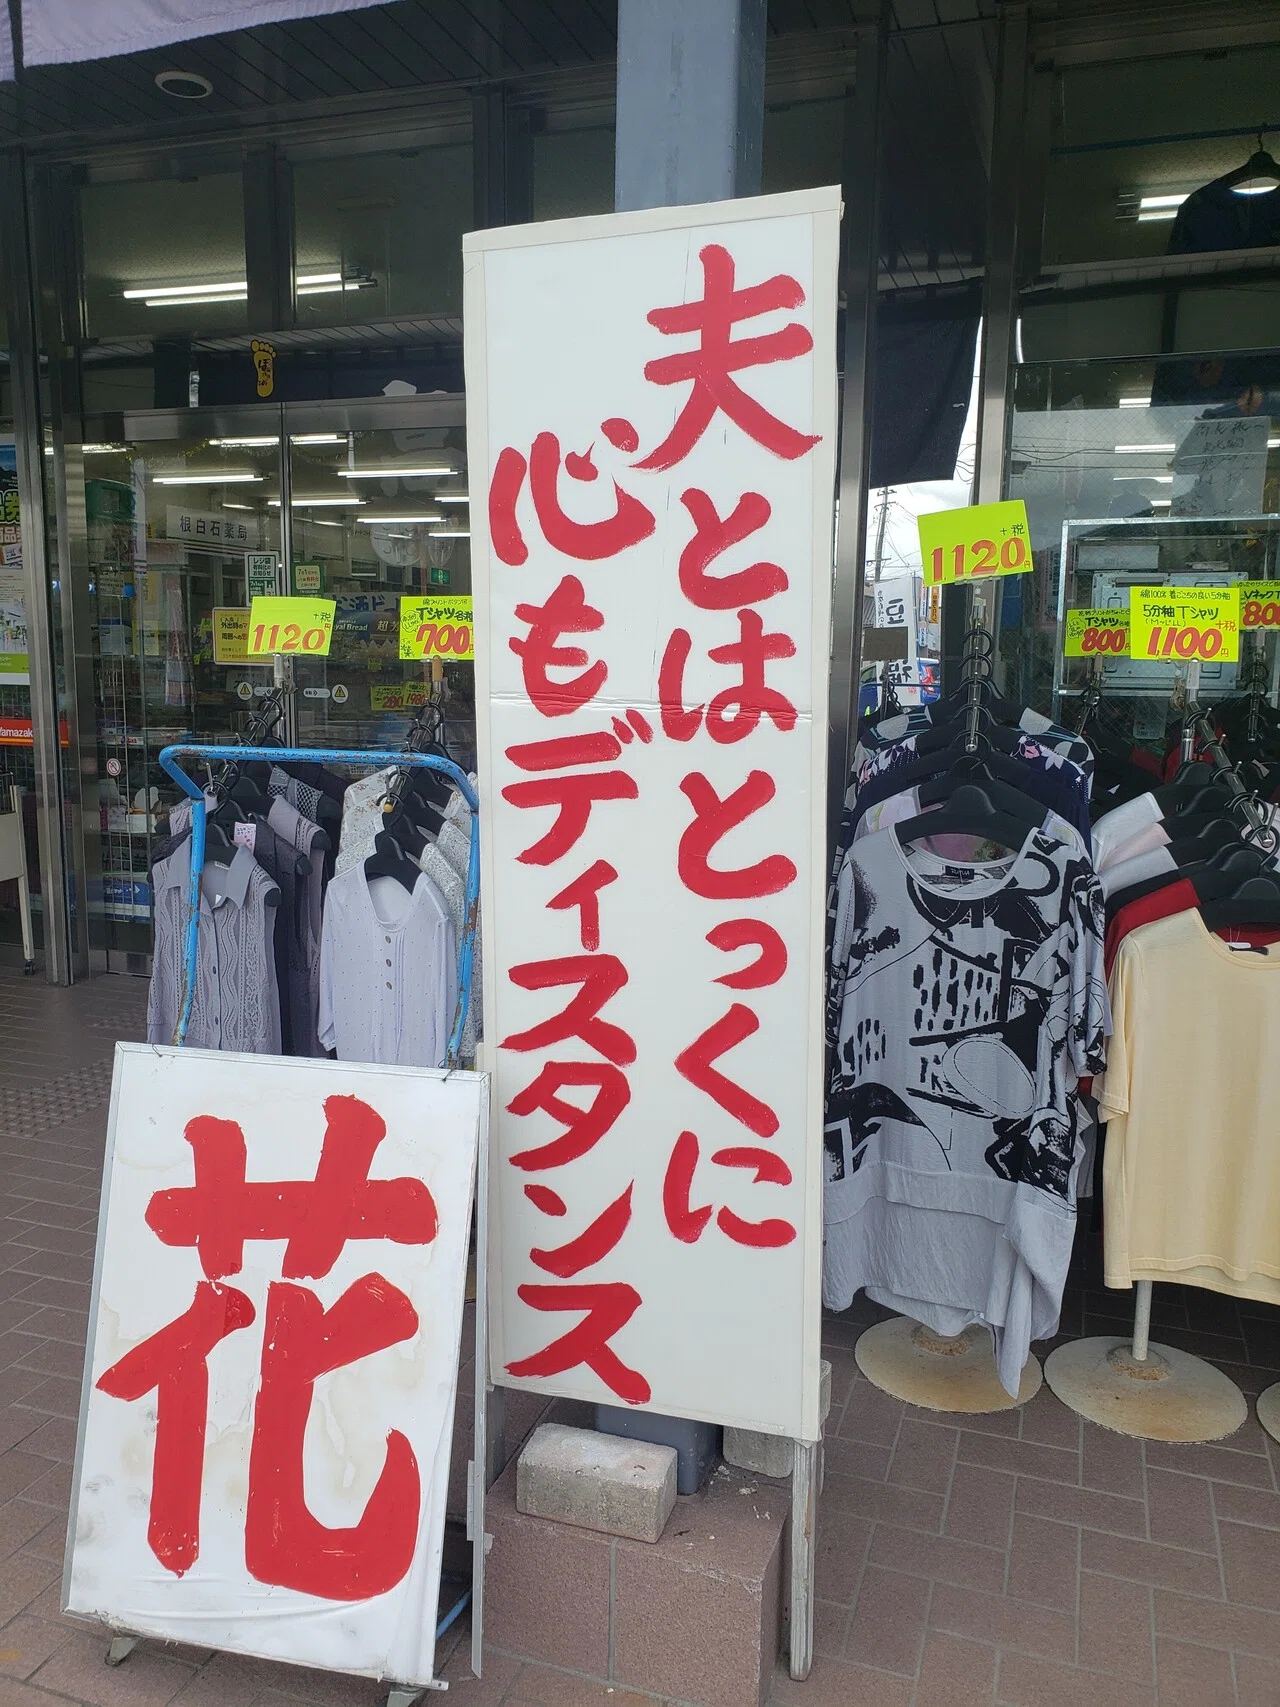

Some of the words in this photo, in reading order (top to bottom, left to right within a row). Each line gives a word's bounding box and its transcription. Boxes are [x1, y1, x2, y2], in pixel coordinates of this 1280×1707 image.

[180, 515, 248, 541] 根白石薬局
[633, 244, 822, 1248] 夫とはとっくに
[488, 418, 655, 1406] 心もディスタンス
[97, 1096, 439, 1602] 花
